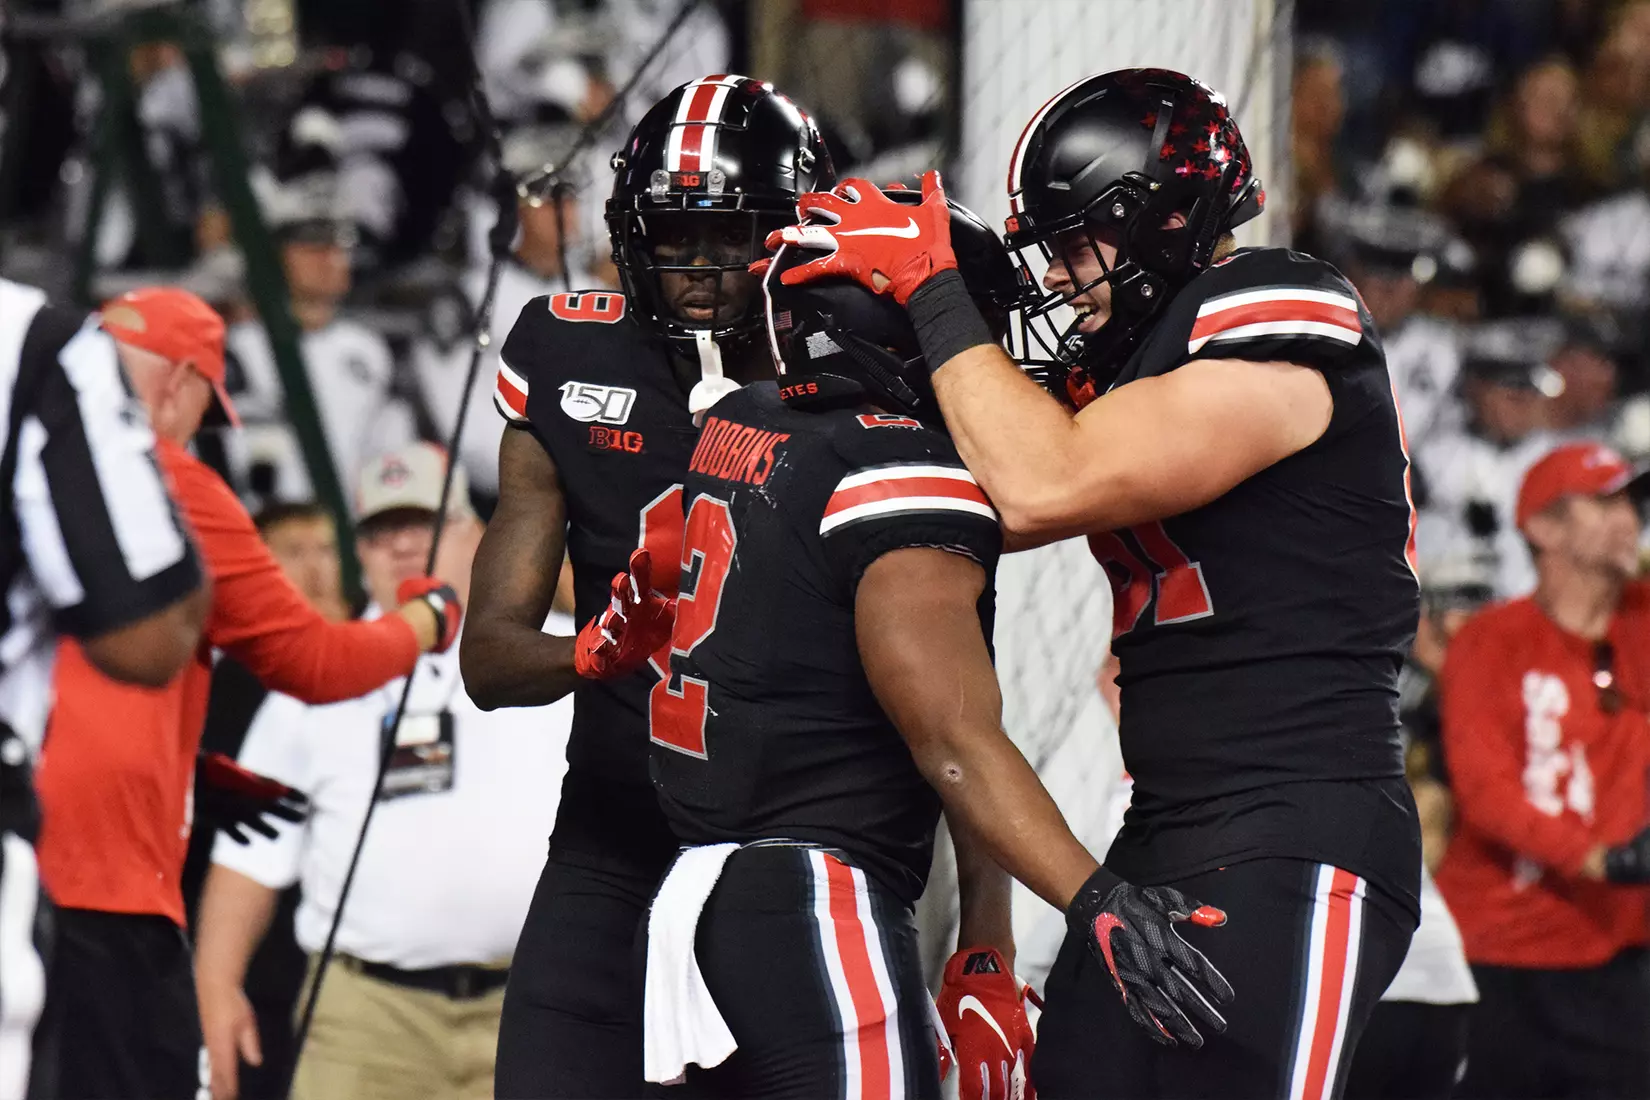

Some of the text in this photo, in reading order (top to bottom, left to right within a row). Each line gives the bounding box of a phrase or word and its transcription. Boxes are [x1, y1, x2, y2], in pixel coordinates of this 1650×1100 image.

[563, 382, 635, 423] 150
[689, 416, 791, 486] DOBBINS
[650, 492, 737, 760] 2
